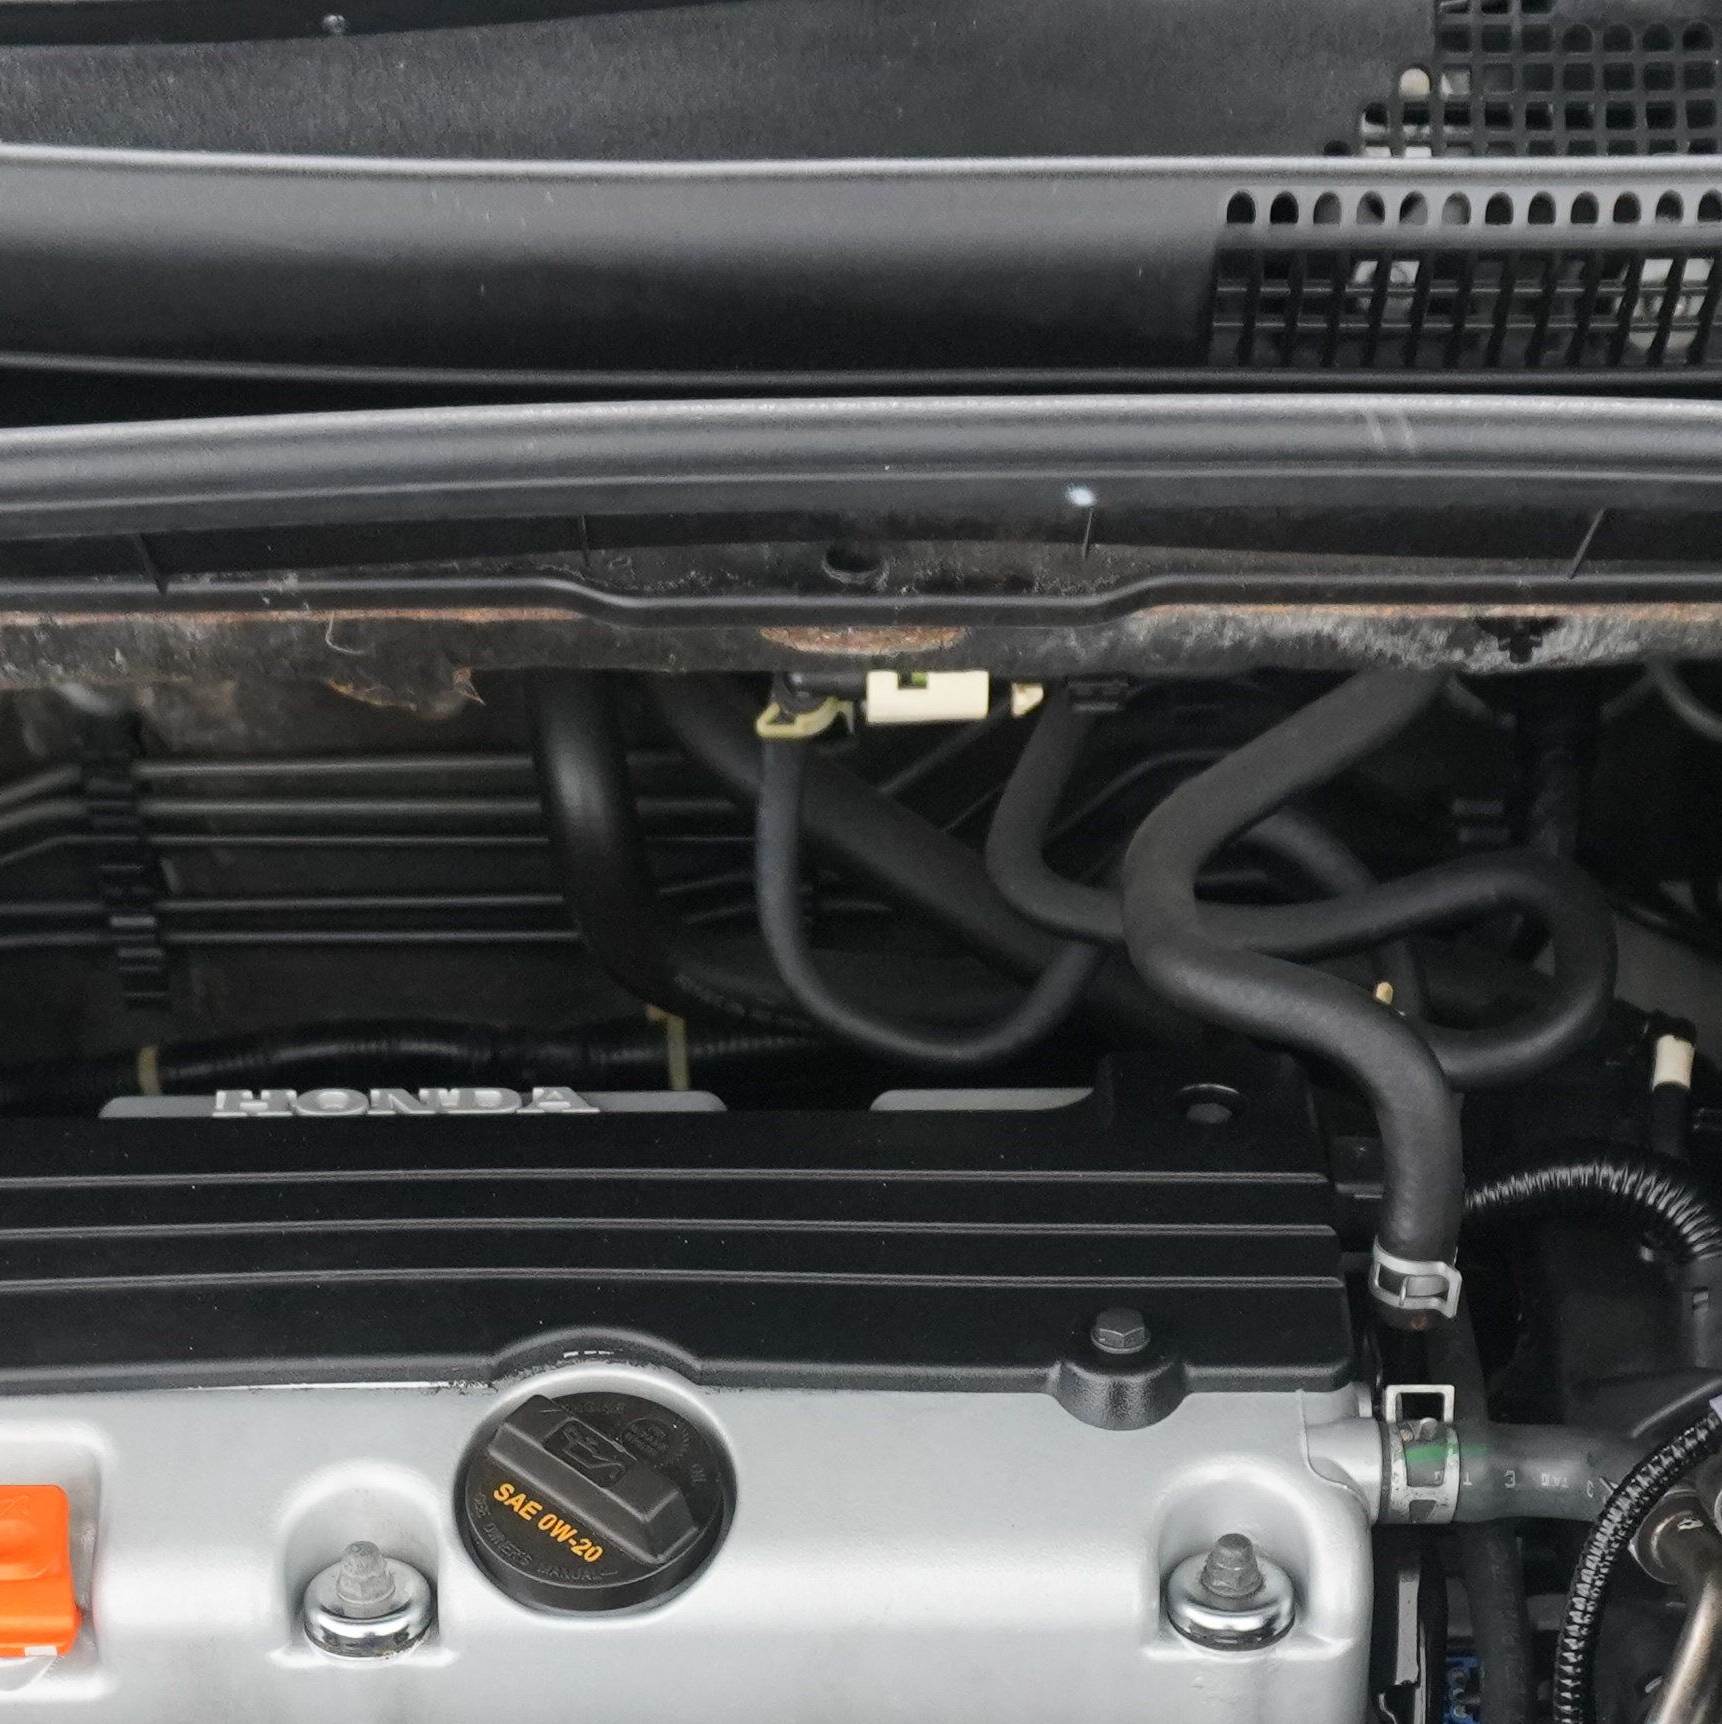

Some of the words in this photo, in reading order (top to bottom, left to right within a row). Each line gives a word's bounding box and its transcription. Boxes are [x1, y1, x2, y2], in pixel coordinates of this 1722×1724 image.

[212, 1087, 600, 1118] HONDA
[494, 1483, 542, 1521] SAE
[537, 1513, 603, 1562] 0W-20
